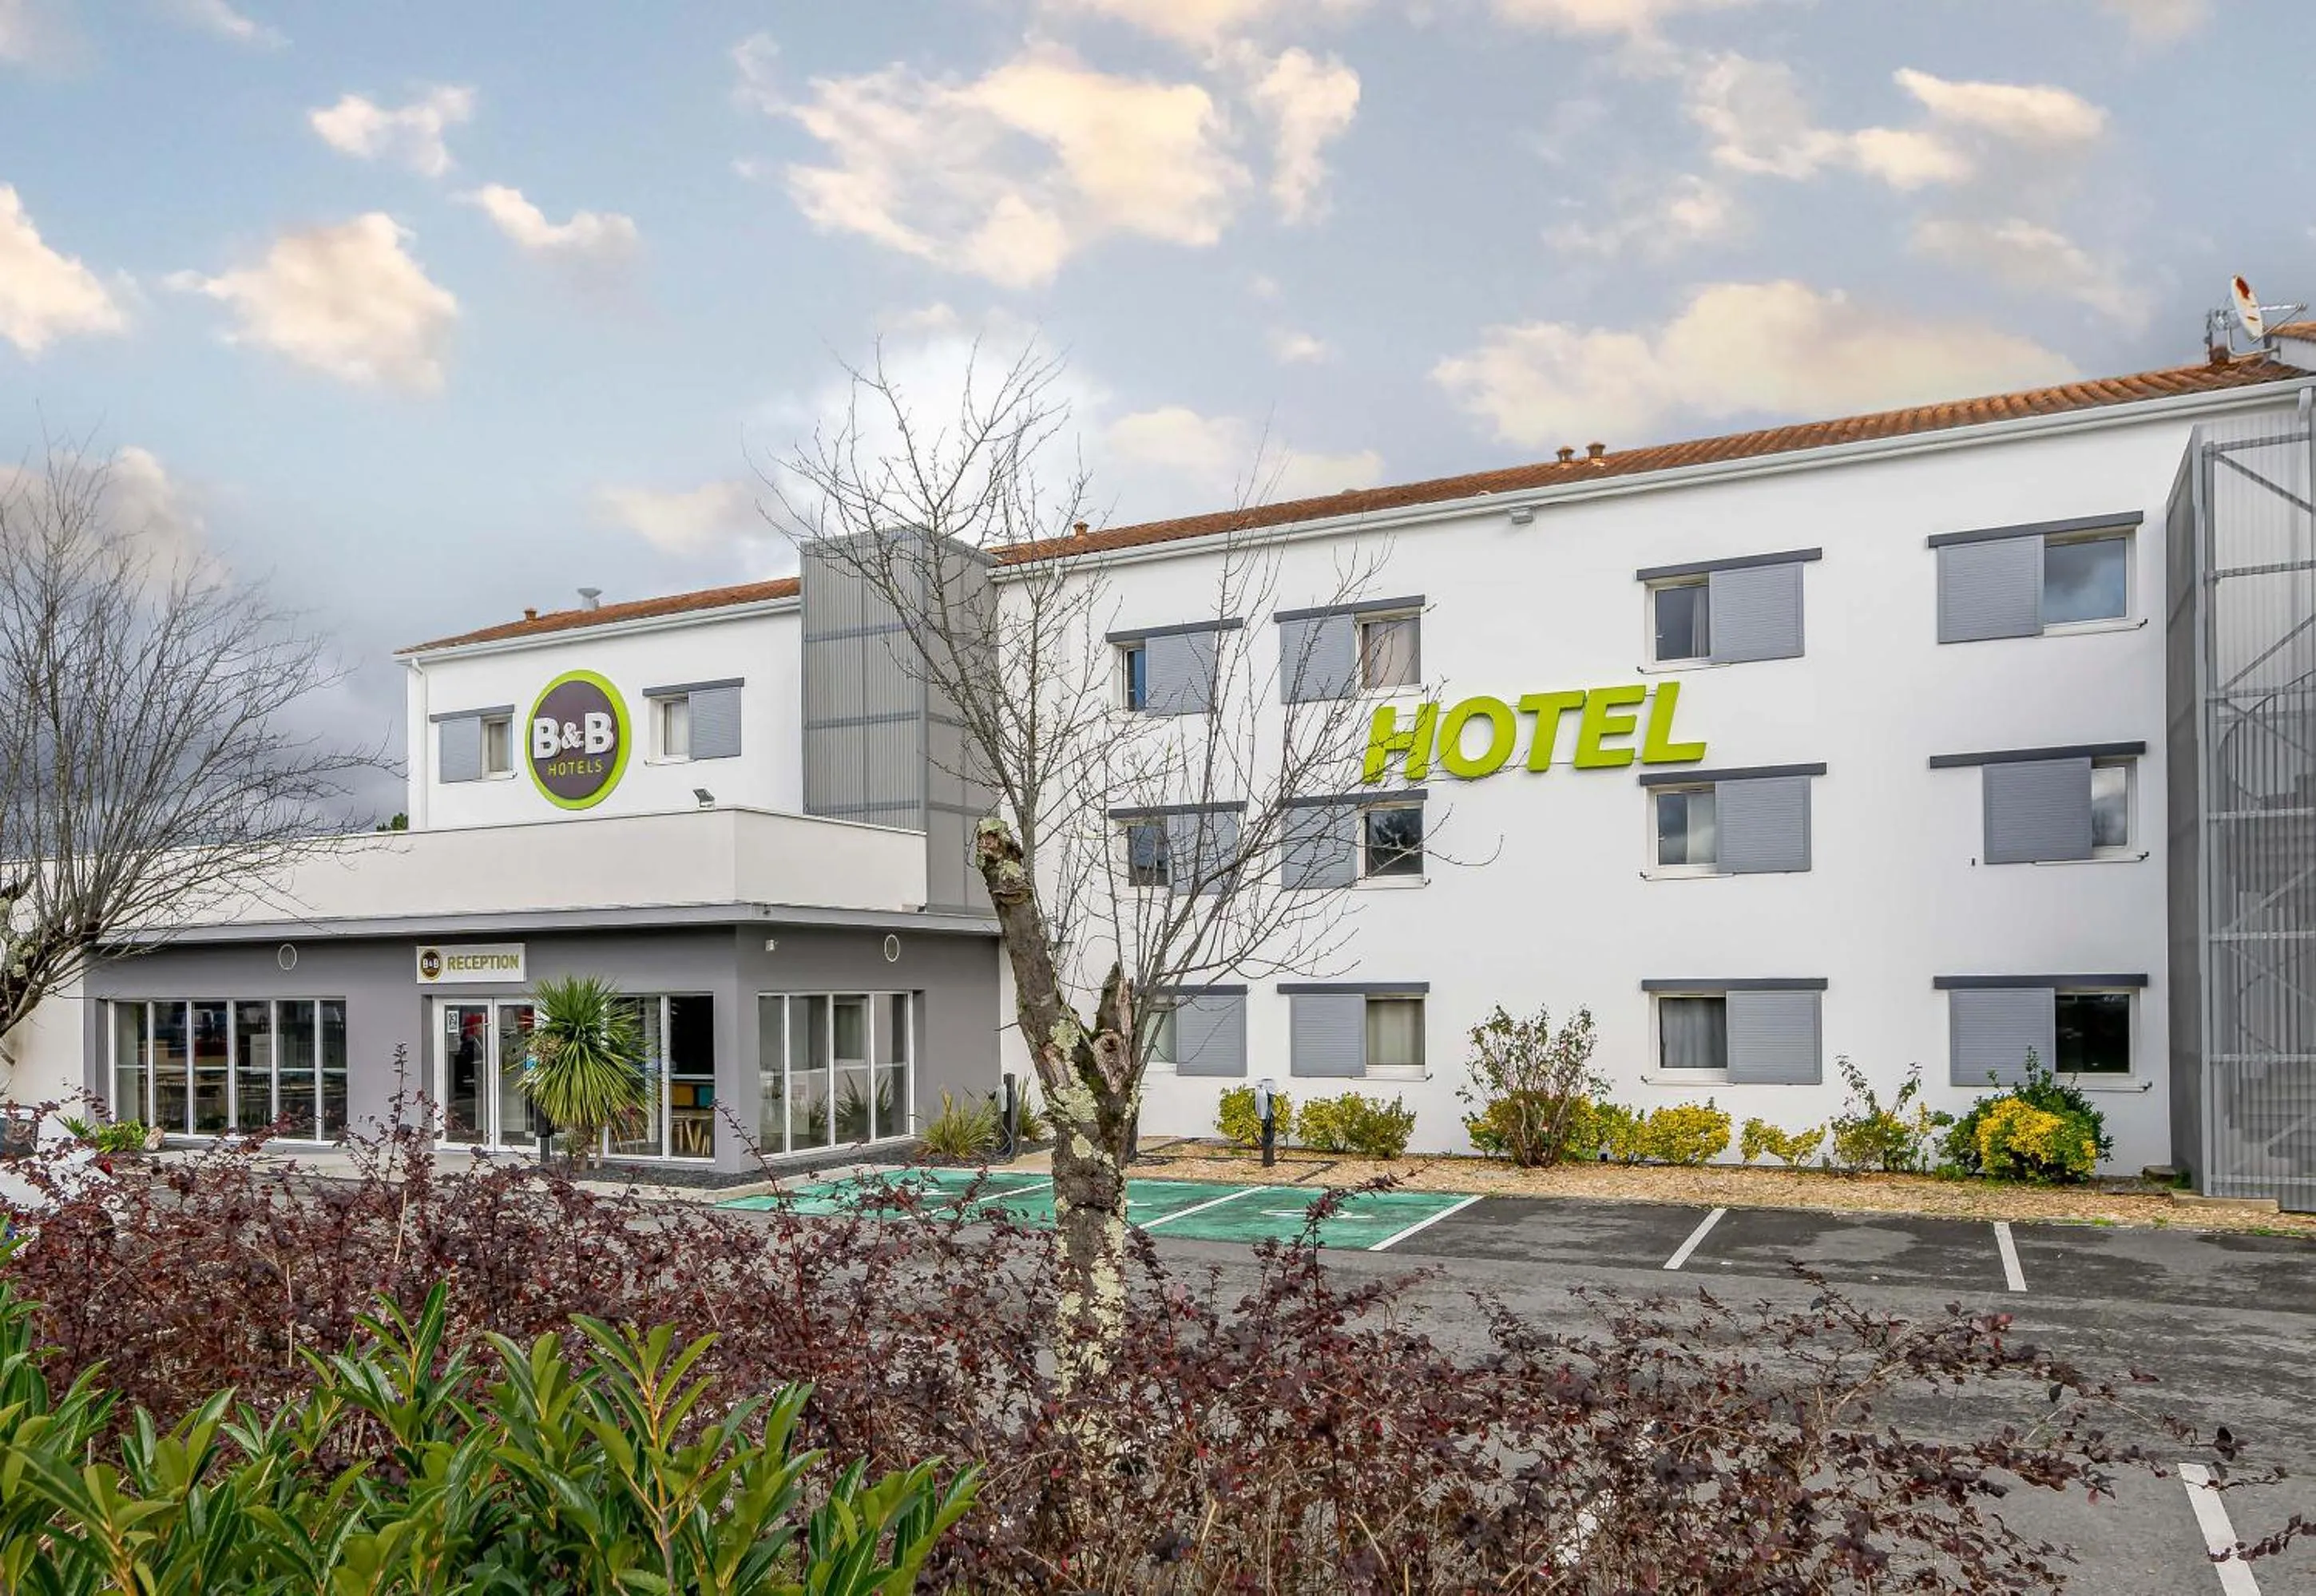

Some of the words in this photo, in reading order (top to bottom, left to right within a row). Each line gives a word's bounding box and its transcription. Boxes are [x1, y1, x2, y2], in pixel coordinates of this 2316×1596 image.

[533, 712, 614, 758] B&B
[1363, 682, 1707, 784] HOTEL
[548, 759, 605, 777] HOTELS
[447, 955, 519, 971] RECEPTION
